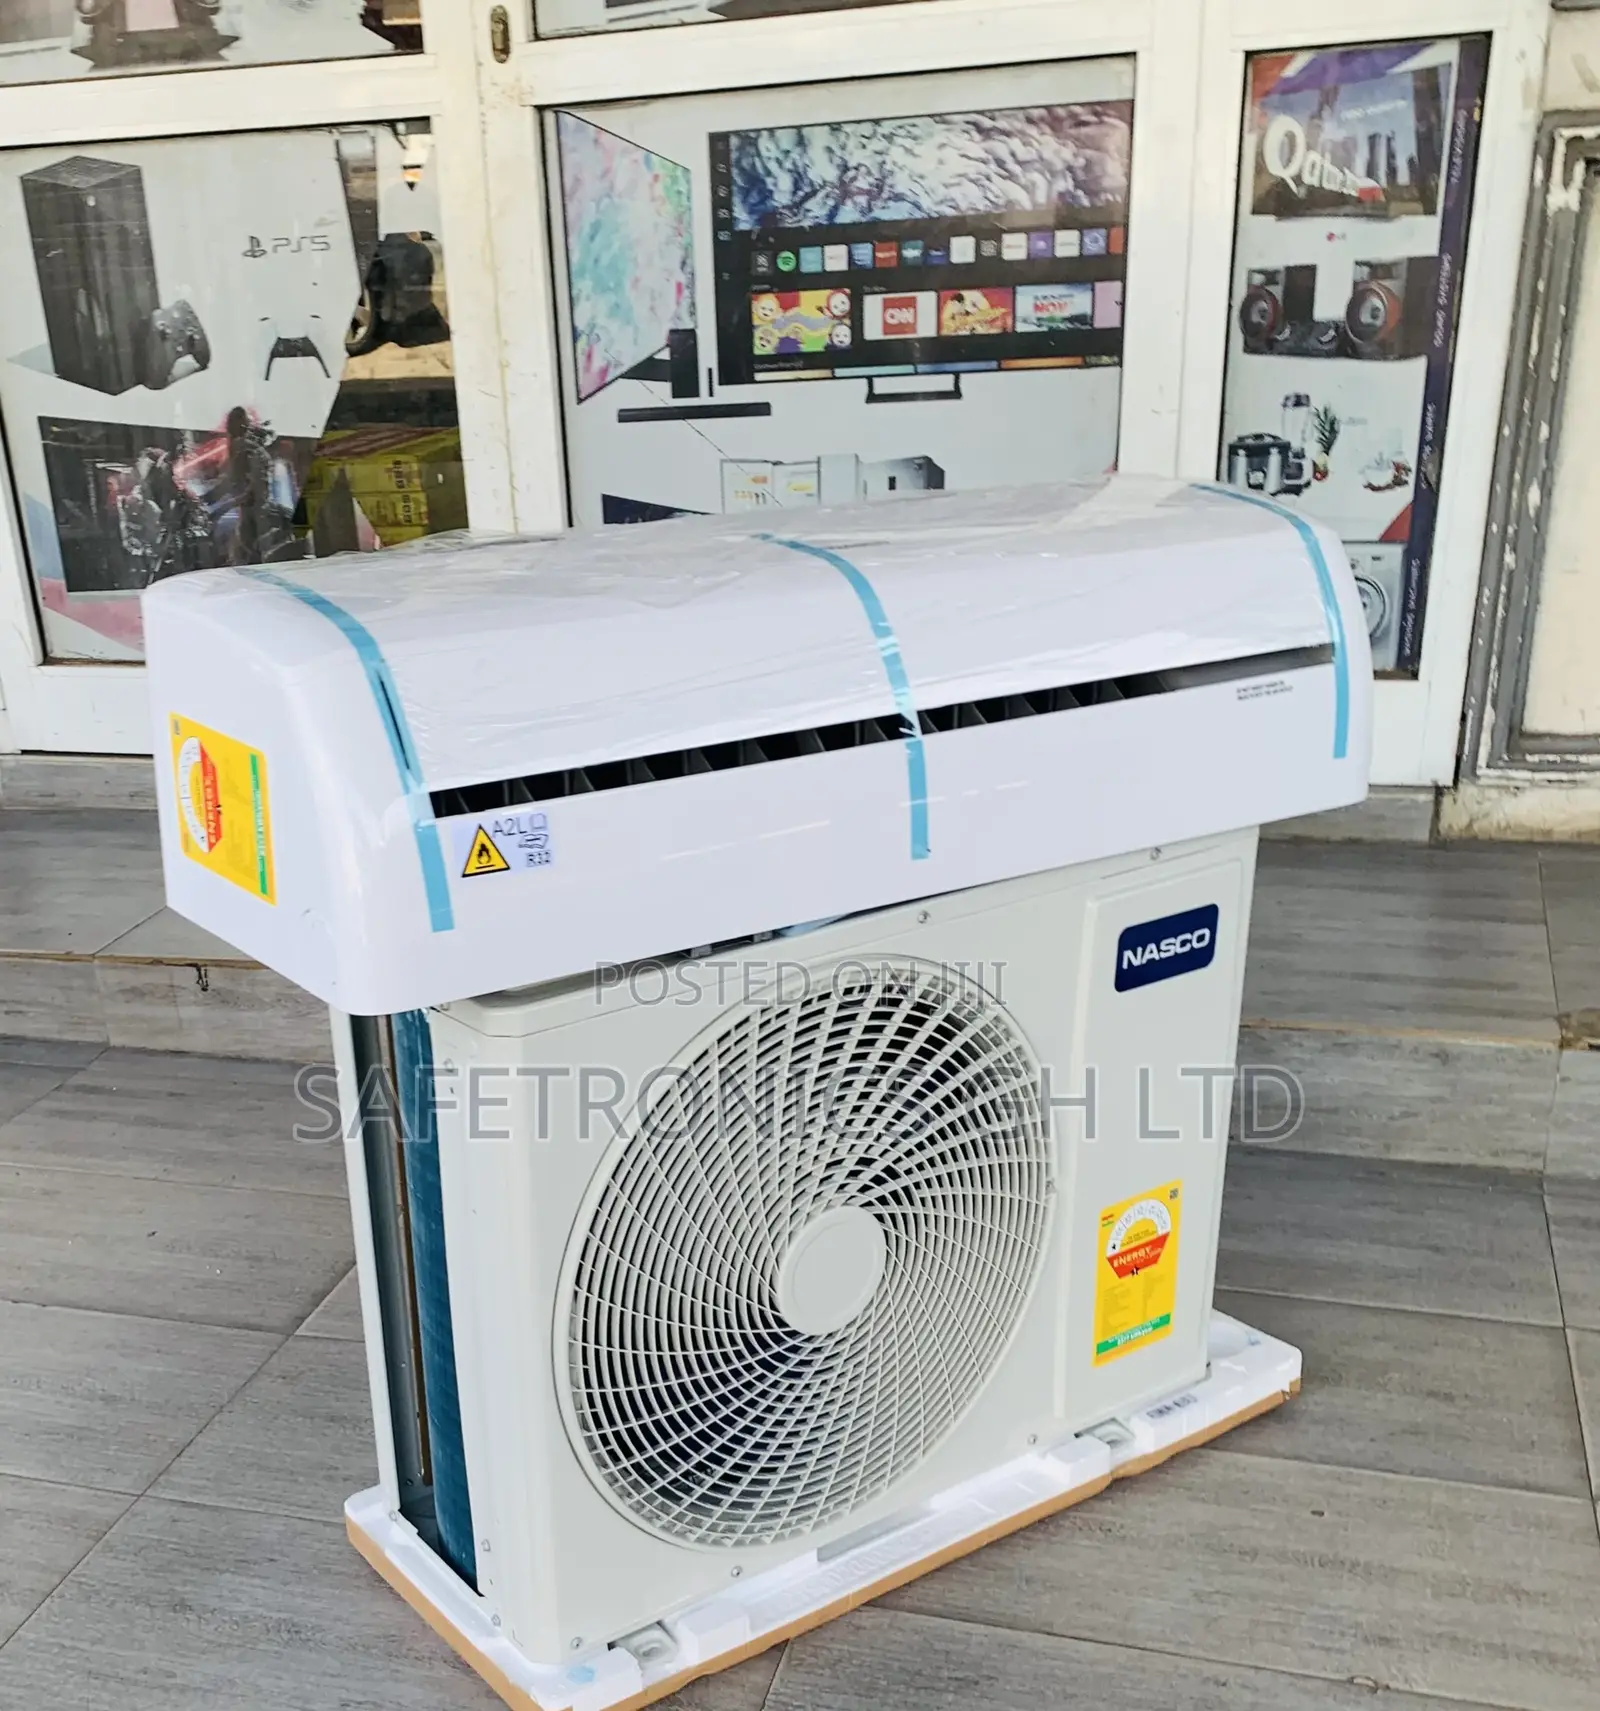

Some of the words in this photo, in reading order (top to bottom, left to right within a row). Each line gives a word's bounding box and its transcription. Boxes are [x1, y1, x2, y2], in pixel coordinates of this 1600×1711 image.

[271, 234, 331, 254] PS5
[884, 307, 915, 324] CNN
[492, 817, 528, 838] A2L
[526, 849, 552, 868] R32
[1122, 927, 1211, 970] NASCO
[1113, 1244, 1152, 1268] ENERGY
